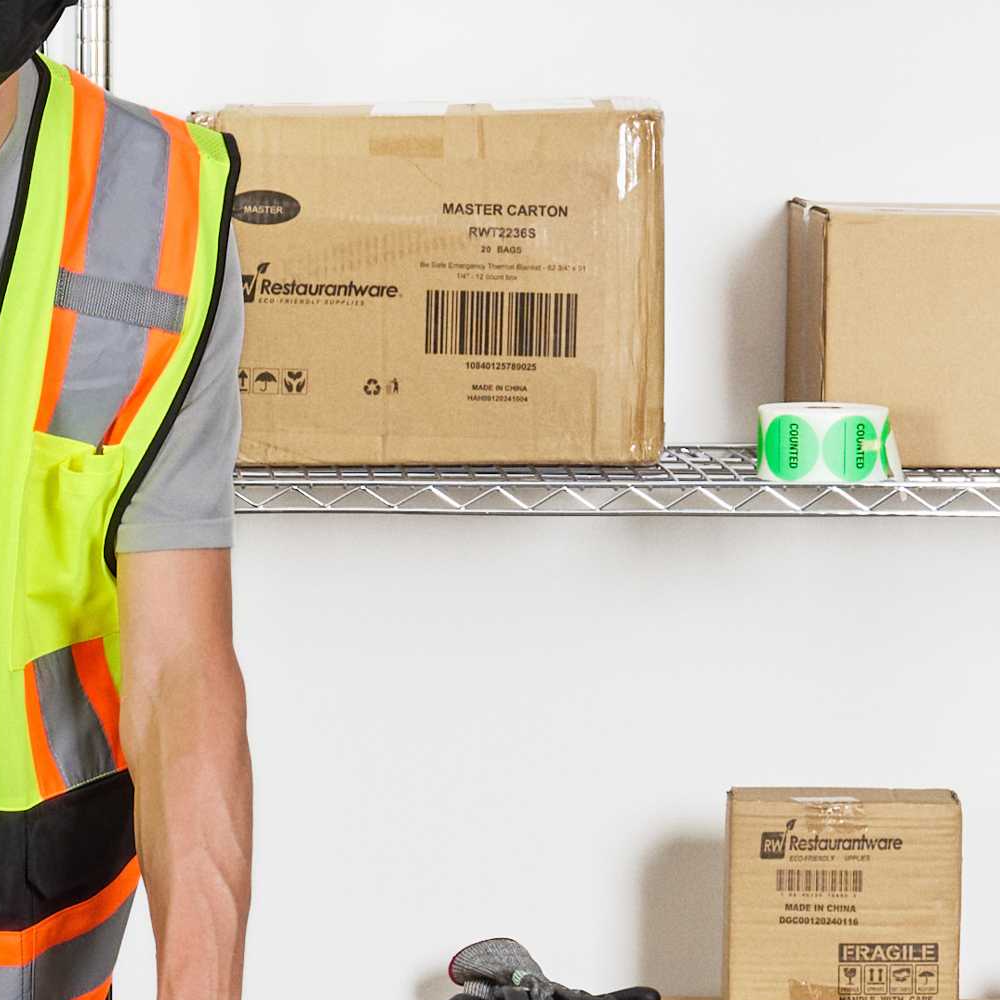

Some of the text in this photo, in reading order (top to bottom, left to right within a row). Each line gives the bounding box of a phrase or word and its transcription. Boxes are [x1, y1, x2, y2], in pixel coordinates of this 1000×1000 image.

[243, 206, 283, 214] MASTER
[442, 203, 568, 217] MASTER CARTON
[468, 226, 536, 239] RWT2236S
[496, 246, 522, 254] BAGS
[260, 279, 398, 298] Restaurantware
[466, 362, 537, 371] 10840125789025
[789, 423, 799, 469] COUNTED
[764, 835, 903, 853] RW Restaurantware
[785, 903, 856, 912] MADE IN CHINA
[843, 945, 936, 961] FRAGILE
